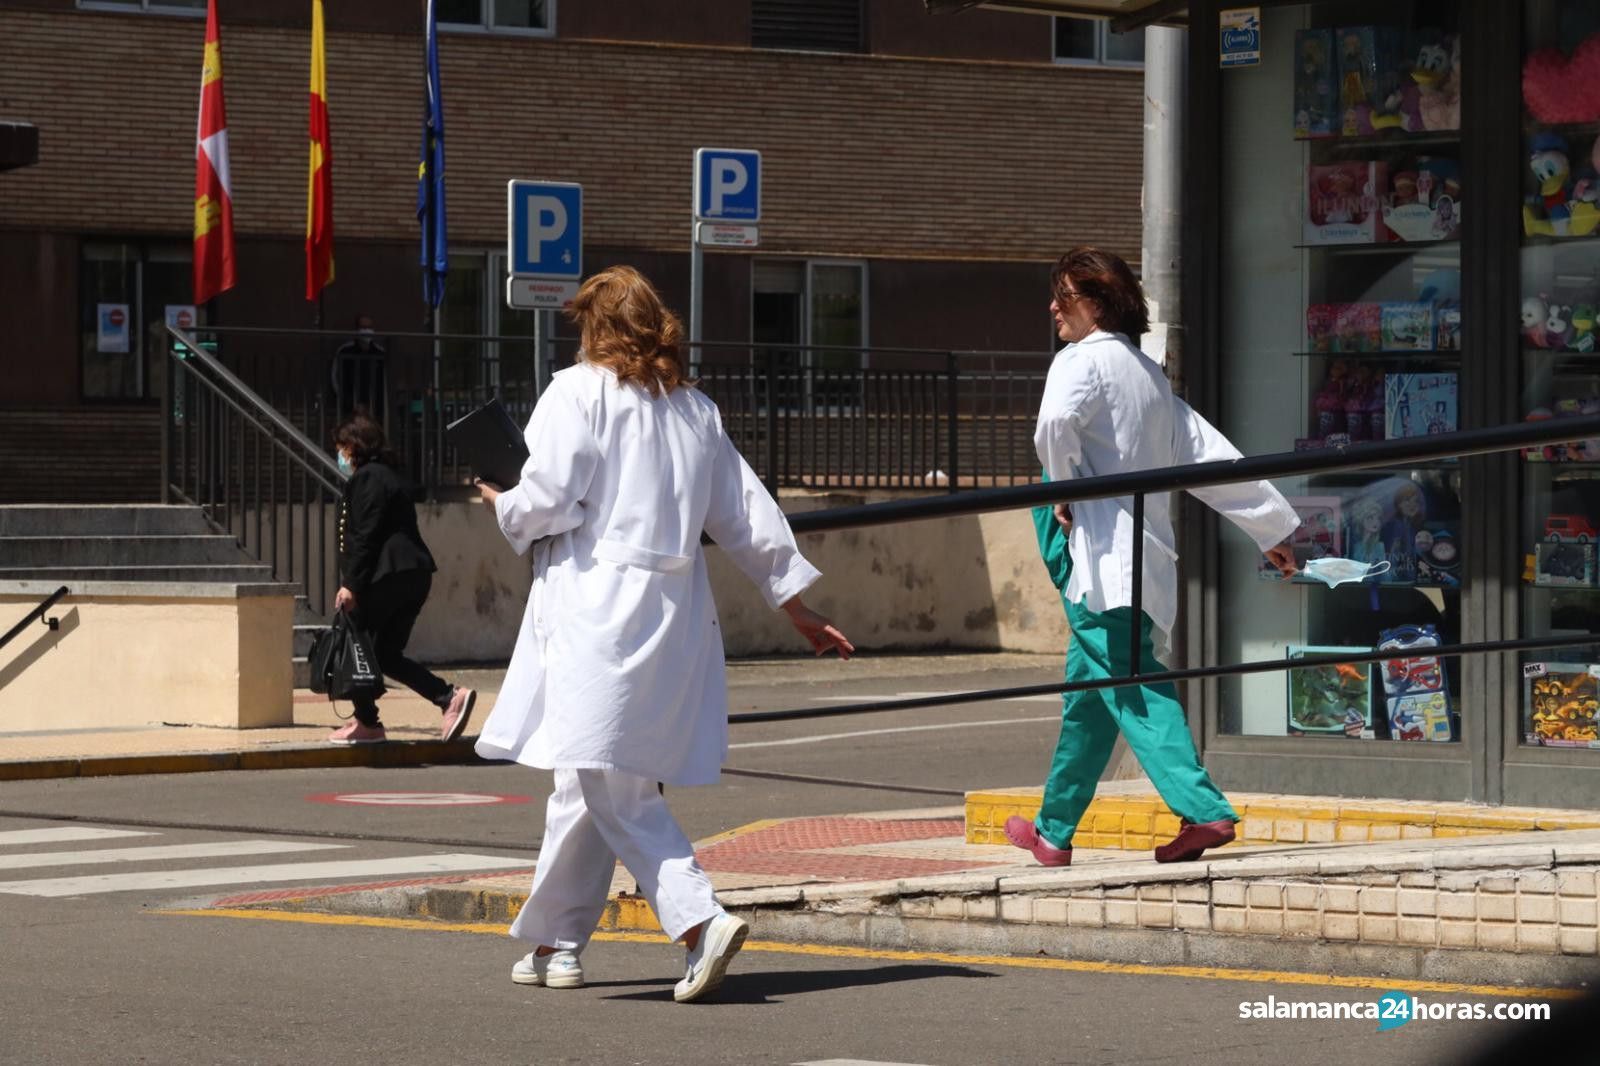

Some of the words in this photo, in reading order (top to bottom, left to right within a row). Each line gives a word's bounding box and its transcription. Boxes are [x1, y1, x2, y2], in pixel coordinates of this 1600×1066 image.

[710, 158, 748, 215] P
[527, 195, 568, 264] P
[528, 285, 564, 293] RESERVADO
